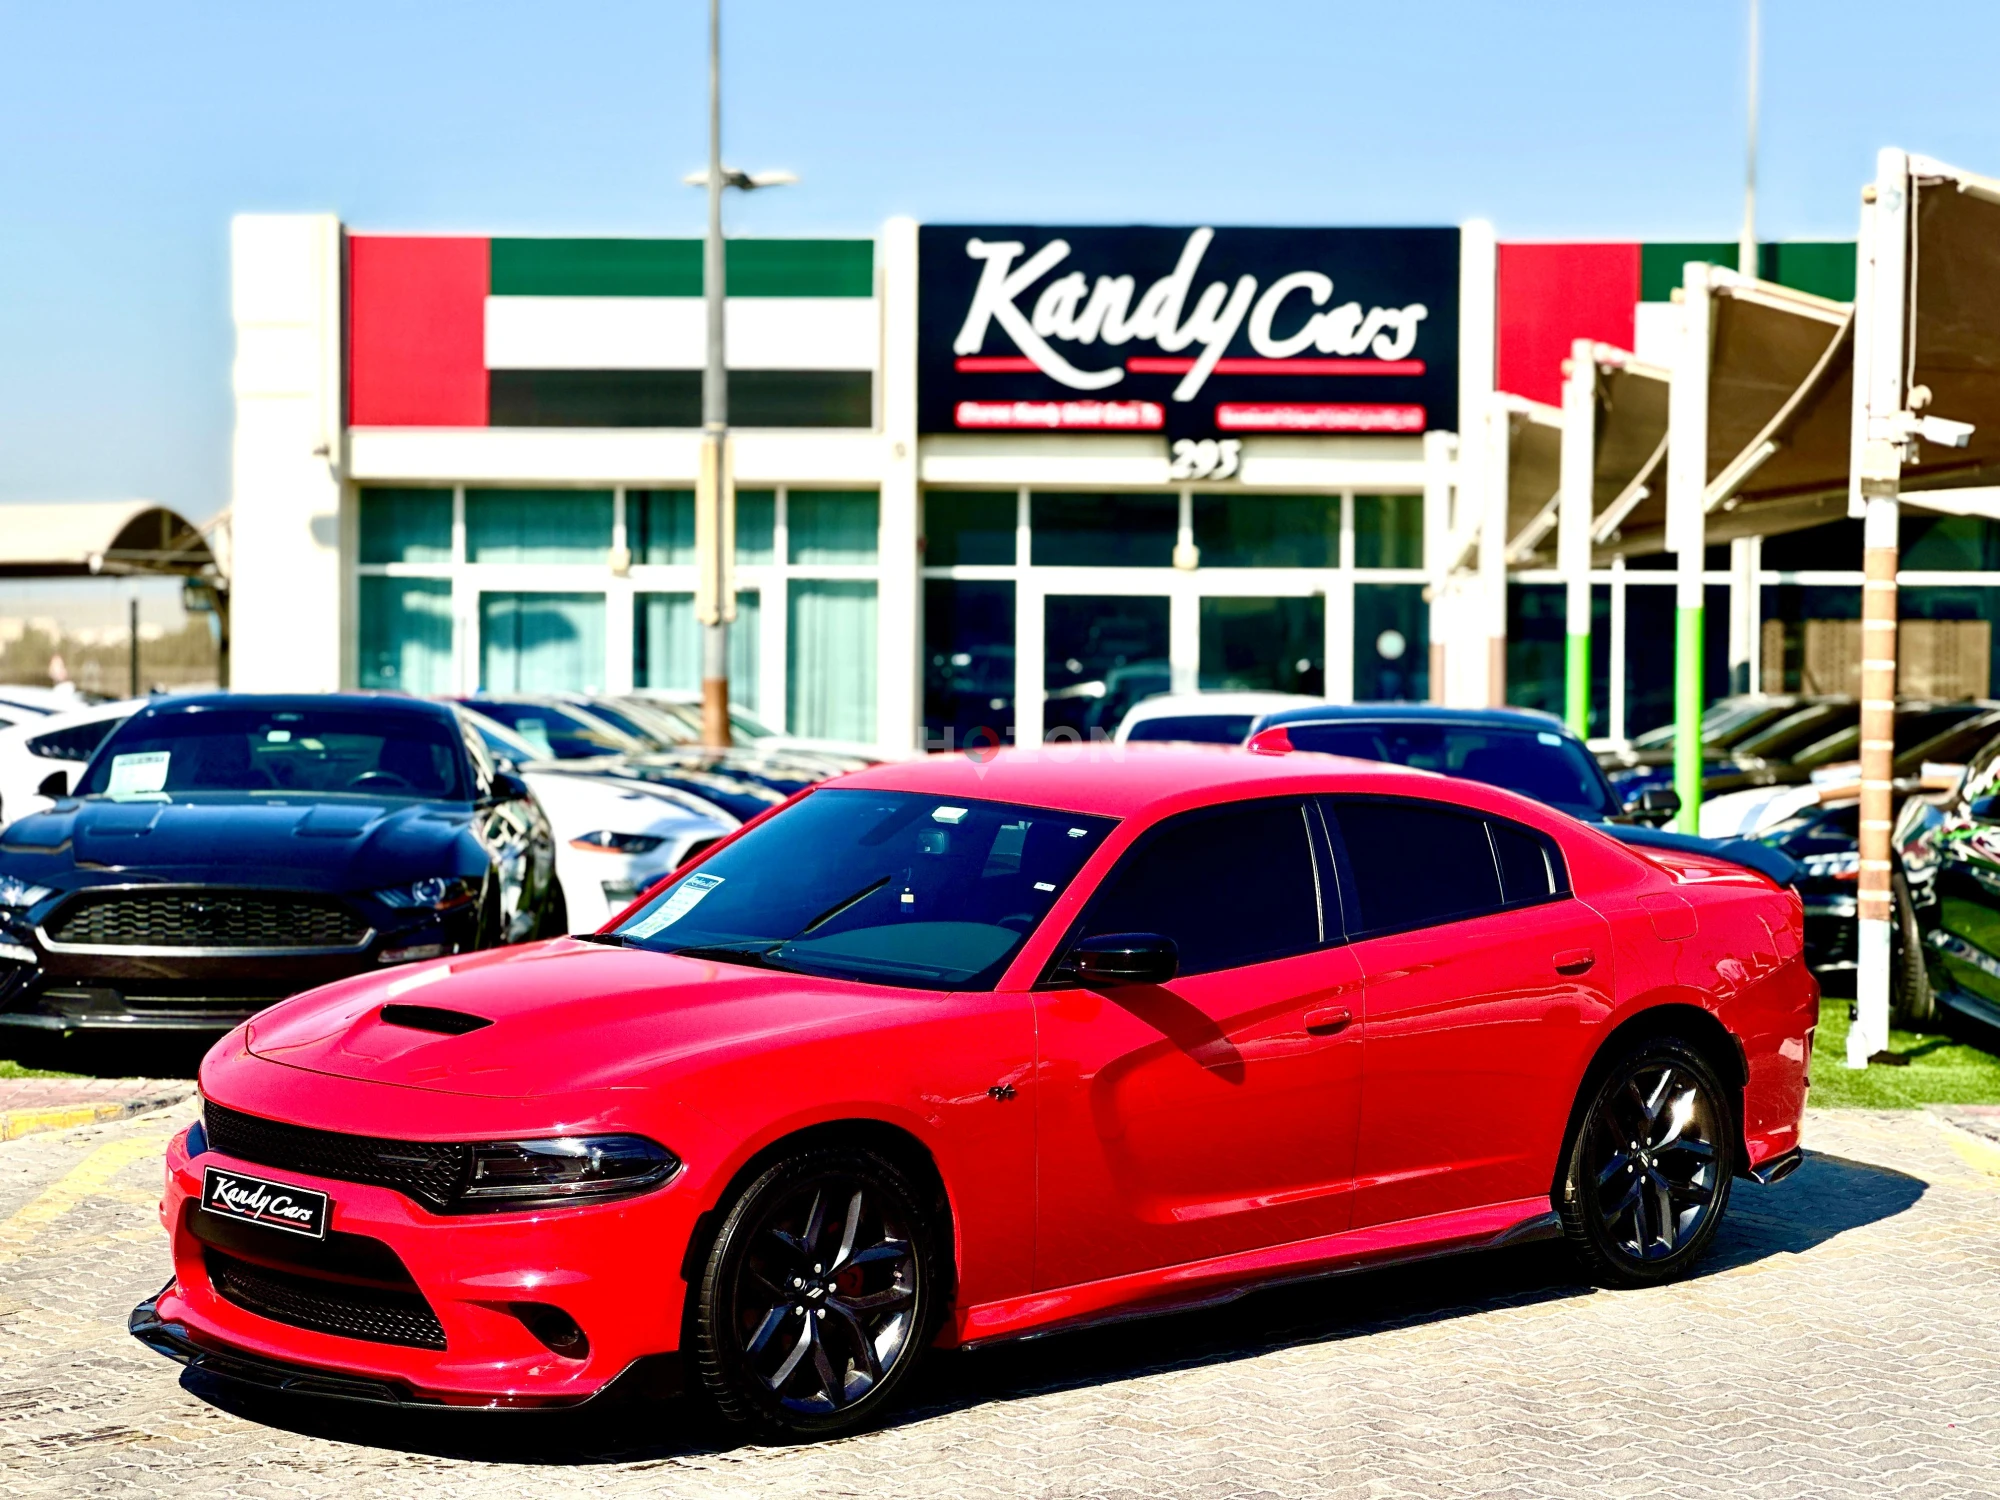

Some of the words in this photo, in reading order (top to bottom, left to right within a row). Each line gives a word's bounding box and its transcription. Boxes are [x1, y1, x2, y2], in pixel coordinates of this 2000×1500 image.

[953, 227, 1257, 401] Kandy
[1248, 270, 1428, 361] Cars
[212, 1176, 272, 1219] Kandy
[269, 1196, 314, 1220] Cars
